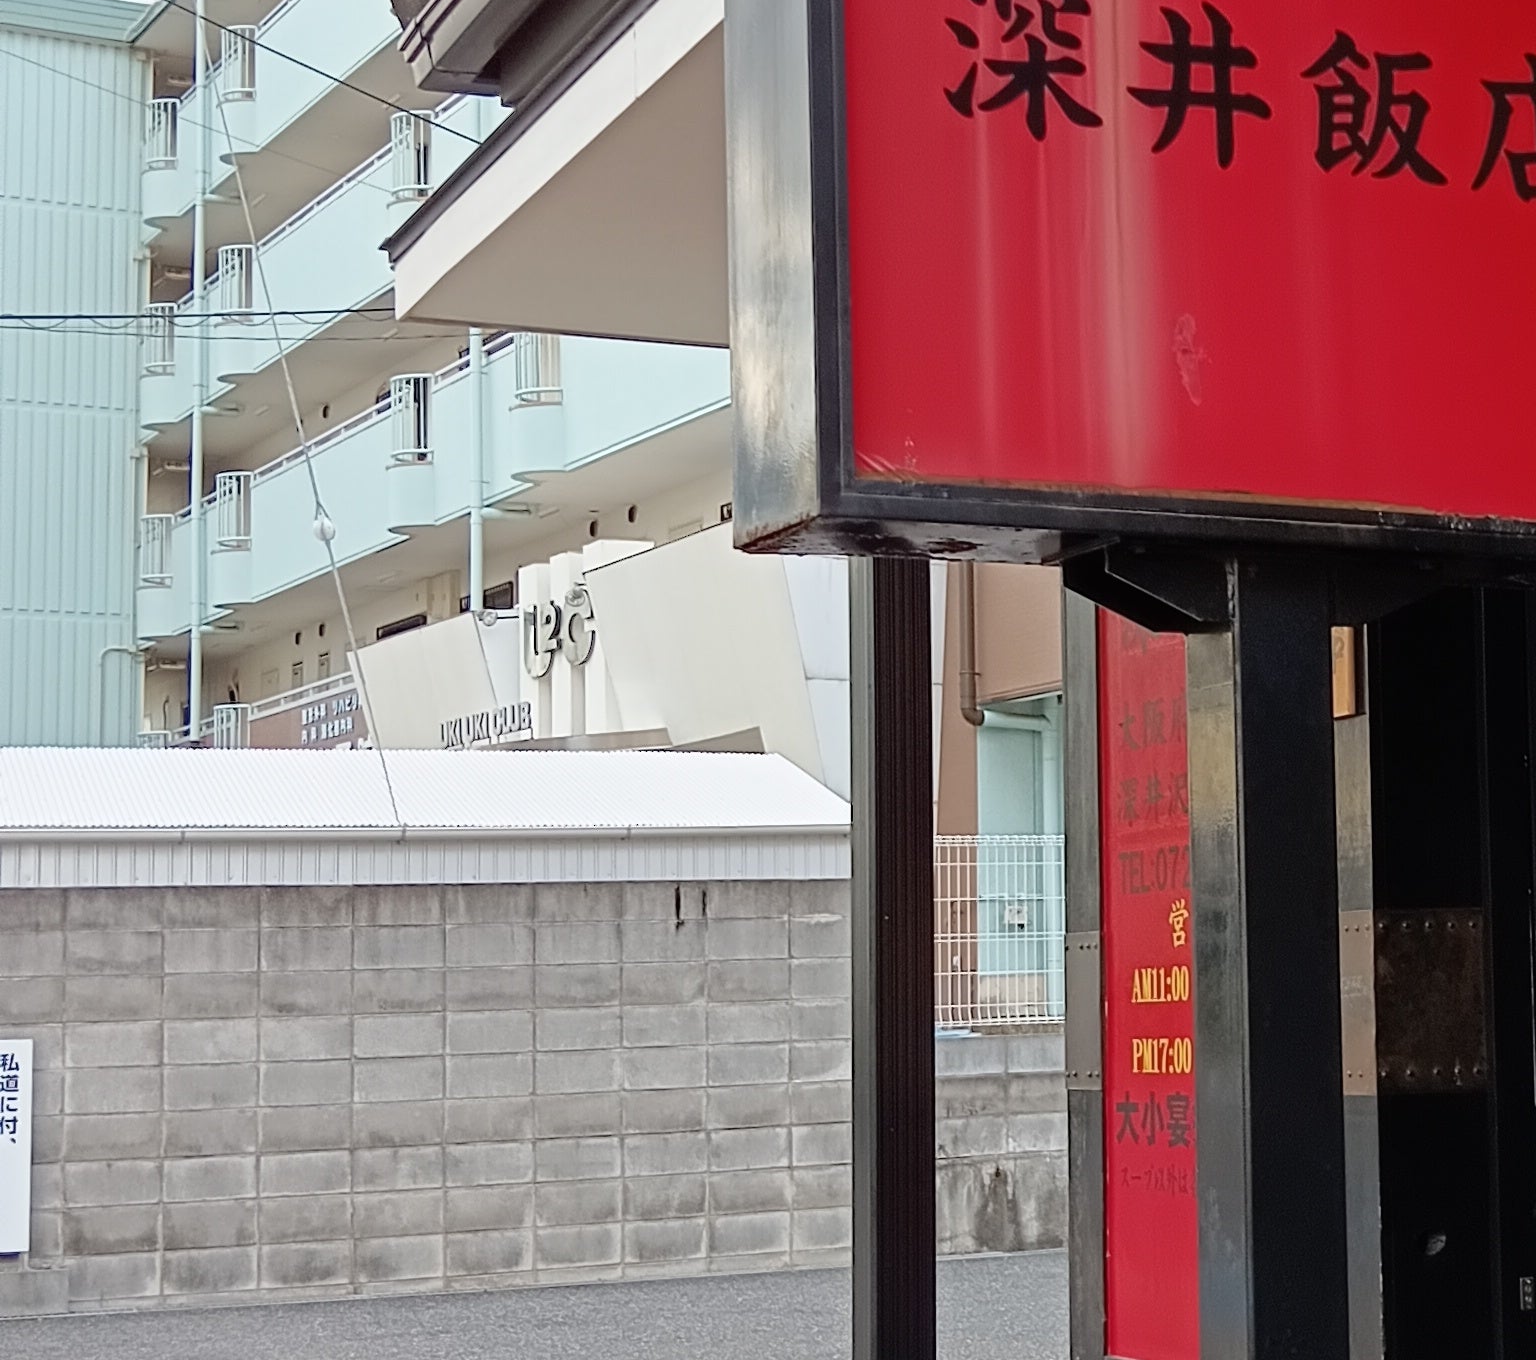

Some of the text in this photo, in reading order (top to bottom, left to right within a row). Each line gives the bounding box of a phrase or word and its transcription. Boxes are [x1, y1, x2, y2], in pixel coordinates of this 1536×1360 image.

[492, 701, 532, 737] CLUB
[1168, 898, 1189, 948] 営
[1131, 965, 1190, 1003] AM11:00
[1131, 1037, 1193, 1074] PM17:00
[1116, 1091, 1196, 1148] 大小宴
